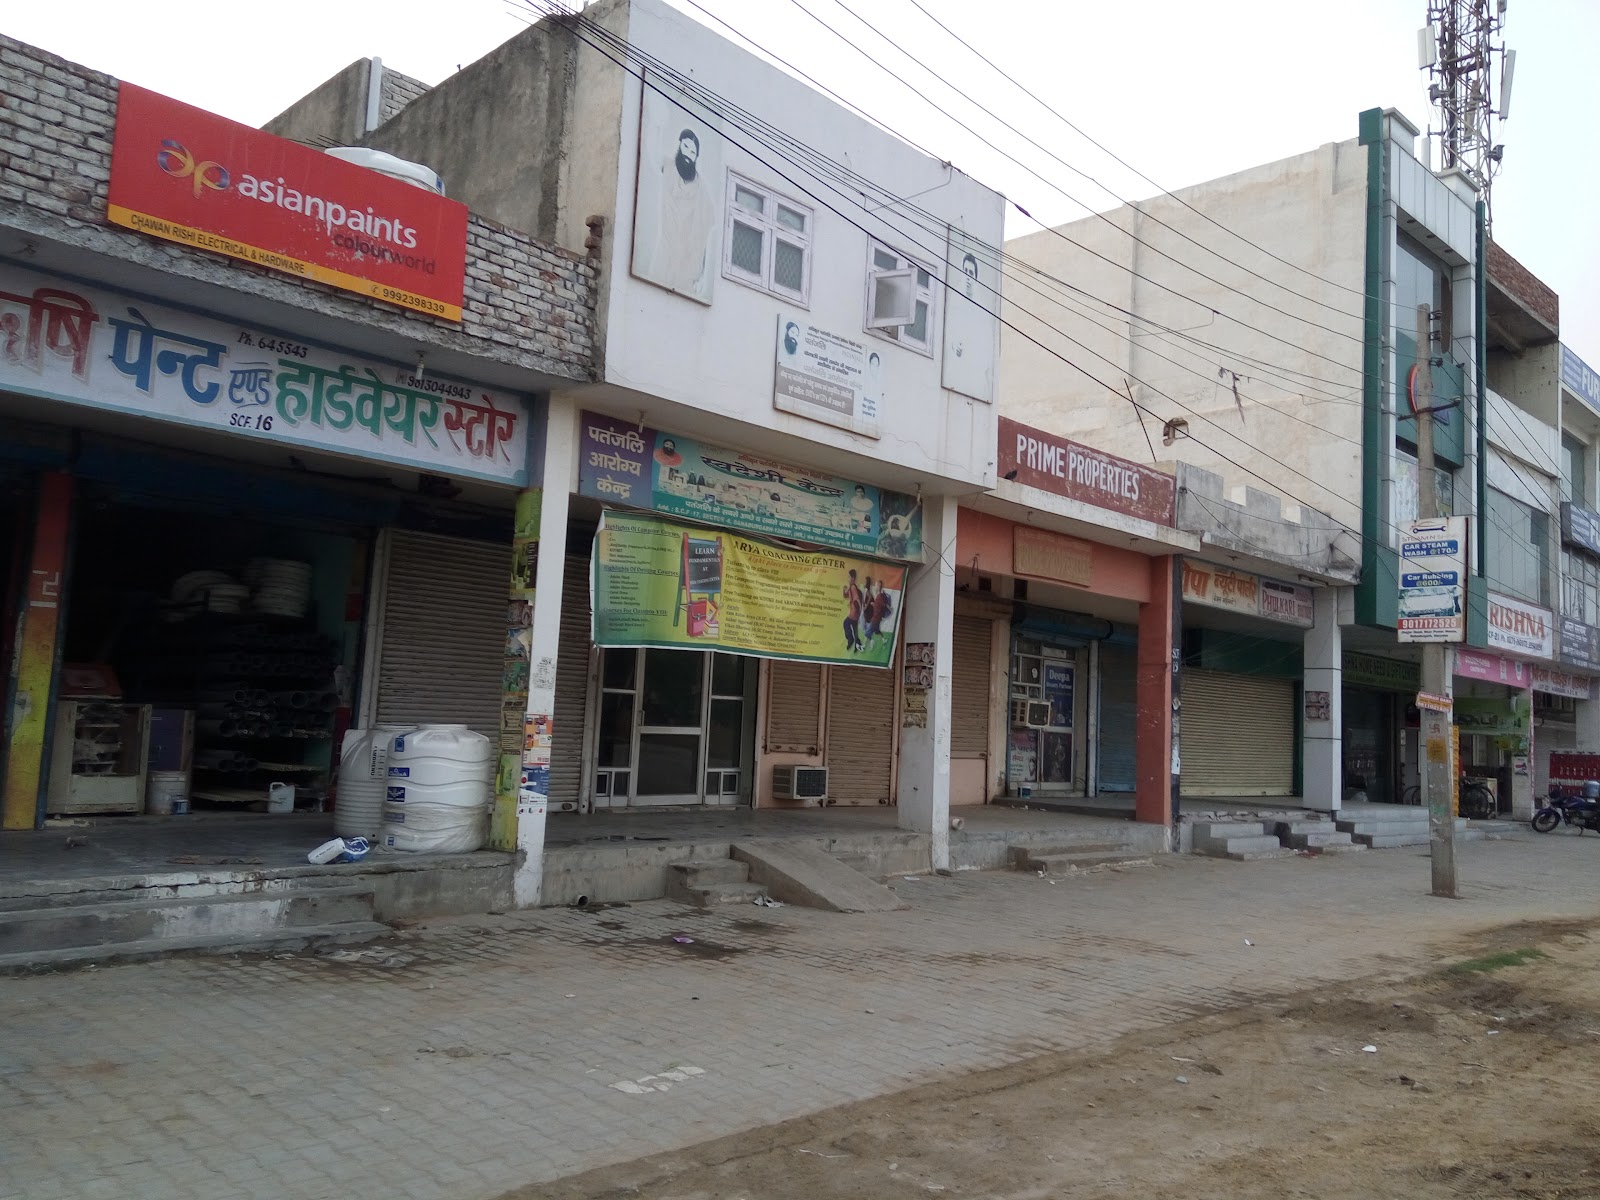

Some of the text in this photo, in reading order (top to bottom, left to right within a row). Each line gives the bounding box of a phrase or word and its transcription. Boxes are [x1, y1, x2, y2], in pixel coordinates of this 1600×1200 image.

[239, 173, 418, 248] asianpaints
[131, 214, 306, 273] CHAWAN RISHI ELECTRICAL & HARDWARE
[335, 233, 435, 275] colourworld
[383, 288, 445, 313] 9992398339
[237, 331, 256, 346] Ph.
[277, 358, 443, 448] हार्डवेयर
[444, 395, 517, 462] स्टोर
[255, 415, 274, 431] 16
[588, 426, 645, 454] पतंजलि
[588, 451, 642, 477] आरोग्य
[1016, 433, 1065, 478] PRIME
[700, 455, 787, 485] स्वदेशी
[1068, 452, 1140, 501] PROPERTIES
[596, 474, 632, 499] केन्द्र
[695, 547, 715, 556] LEARN
[763, 549, 811, 565] COACHING
[812, 556, 846, 569] CENTER
[1422, 573, 1454, 581] Rubbing
[1402, 618, 1457, 629] 9017172525
[1049, 670, 1071, 683] Deepa
